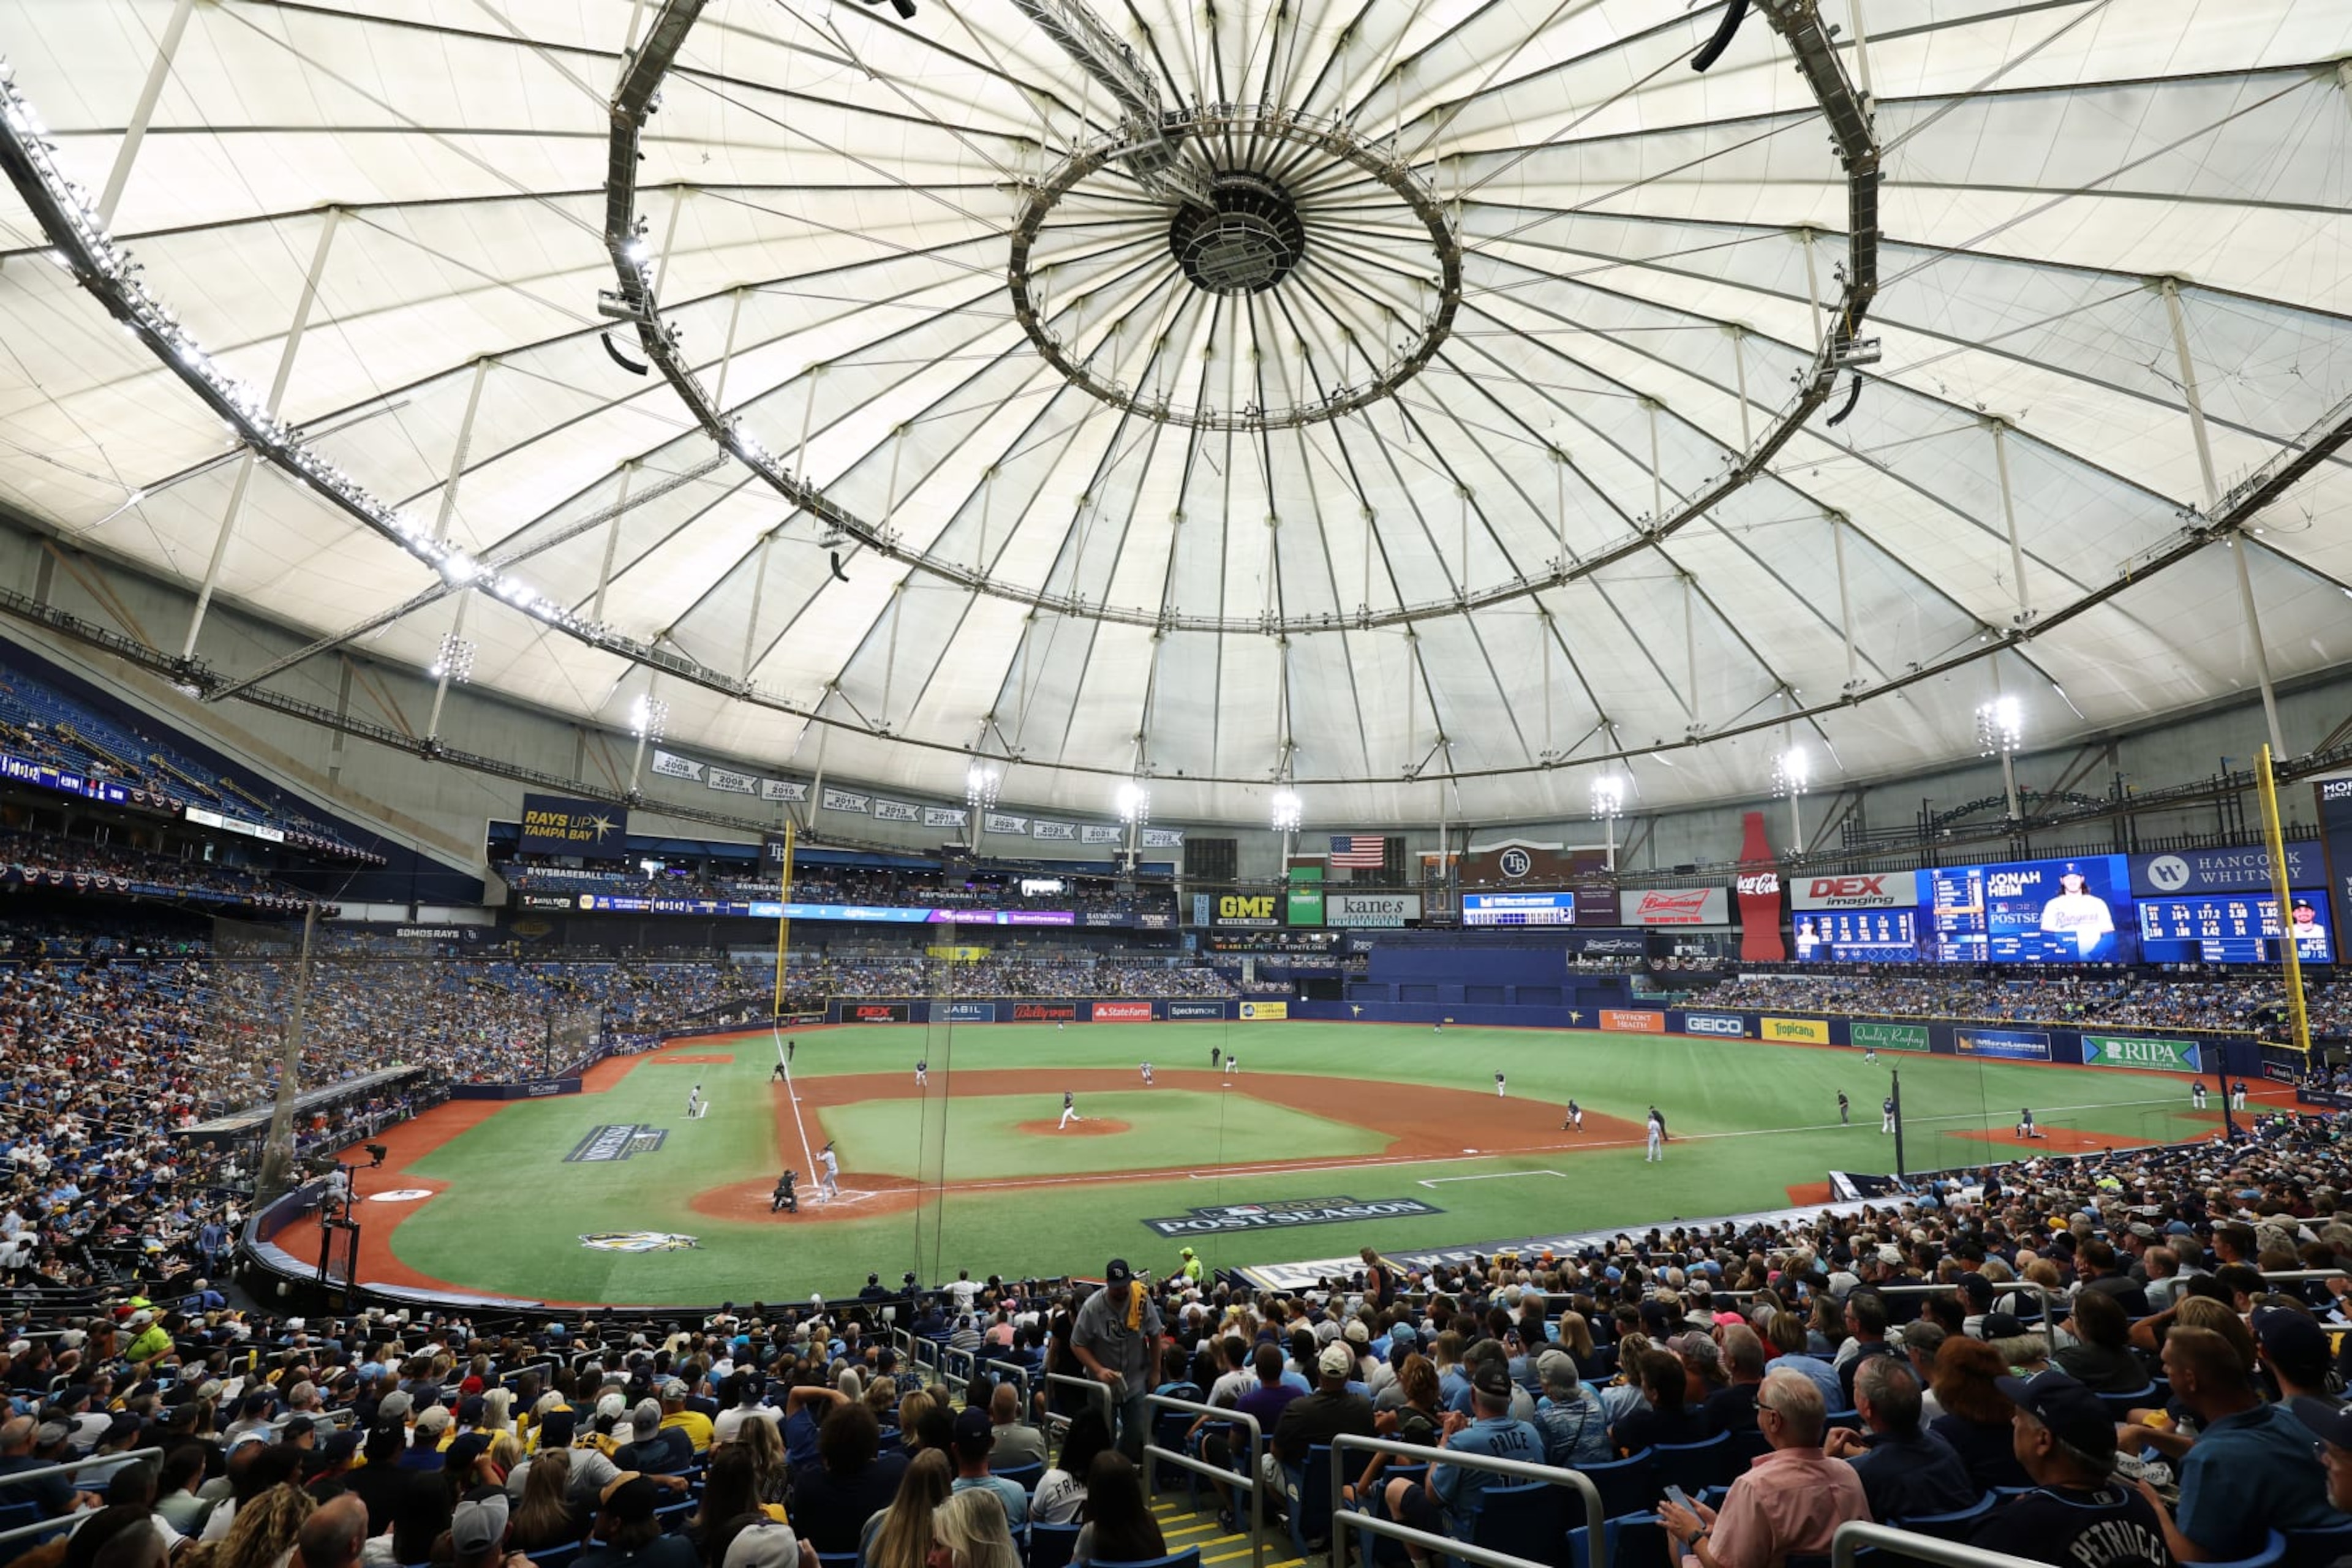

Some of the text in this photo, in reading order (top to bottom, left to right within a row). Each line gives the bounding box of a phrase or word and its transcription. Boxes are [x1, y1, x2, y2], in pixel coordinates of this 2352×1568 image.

[665, 760, 690, 772] 2008
[657, 766, 695, 780] CHAMPIONS
[712, 782, 750, 793] CHAMPIONS
[719, 776, 744, 786] 2008
[772, 786, 795, 795] 2010
[834, 796, 857, 805] 2011
[525, 810, 592, 828] RAYS UP
[523, 825, 593, 842] TAMPA BAY
[1987, 870, 2041, 886] JONAH
[1809, 875, 1887, 899] DEX
[1988, 884, 2023, 898] HEIM
[1219, 896, 1276, 918] GMF
[1643, 897, 1702, 909] Budweiser
[1826, 895, 1895, 907] imaging
[1197, 906, 1205, 914] 12
[396, 928, 460, 939] SOMOS RAYS
[857, 1006, 891, 1017] DEX
[943, 1005, 981, 1014] JABIL
[1107, 1006, 1150, 1017] State Farm
[1613, 1012, 1652, 1022] BAYFRONT
[1617, 1020, 1648, 1030] HEALTH
[1687, 1017, 1741, 1033] GEICO
[1774, 1021, 1815, 1038] Tropicana
[1854, 1025, 1924, 1047] Quality Roofing
[1975, 1038, 2046, 1049] MicroLumen
[2123, 1042, 2179, 1063] RIPA
[1156, 1199, 1427, 1233] POSTSEASON
[1402, 1235, 1601, 1268] WELCOME
[1488, 1431, 1529, 1456] PRICE
[2069, 1520, 2167, 1568] PETRUCCI
